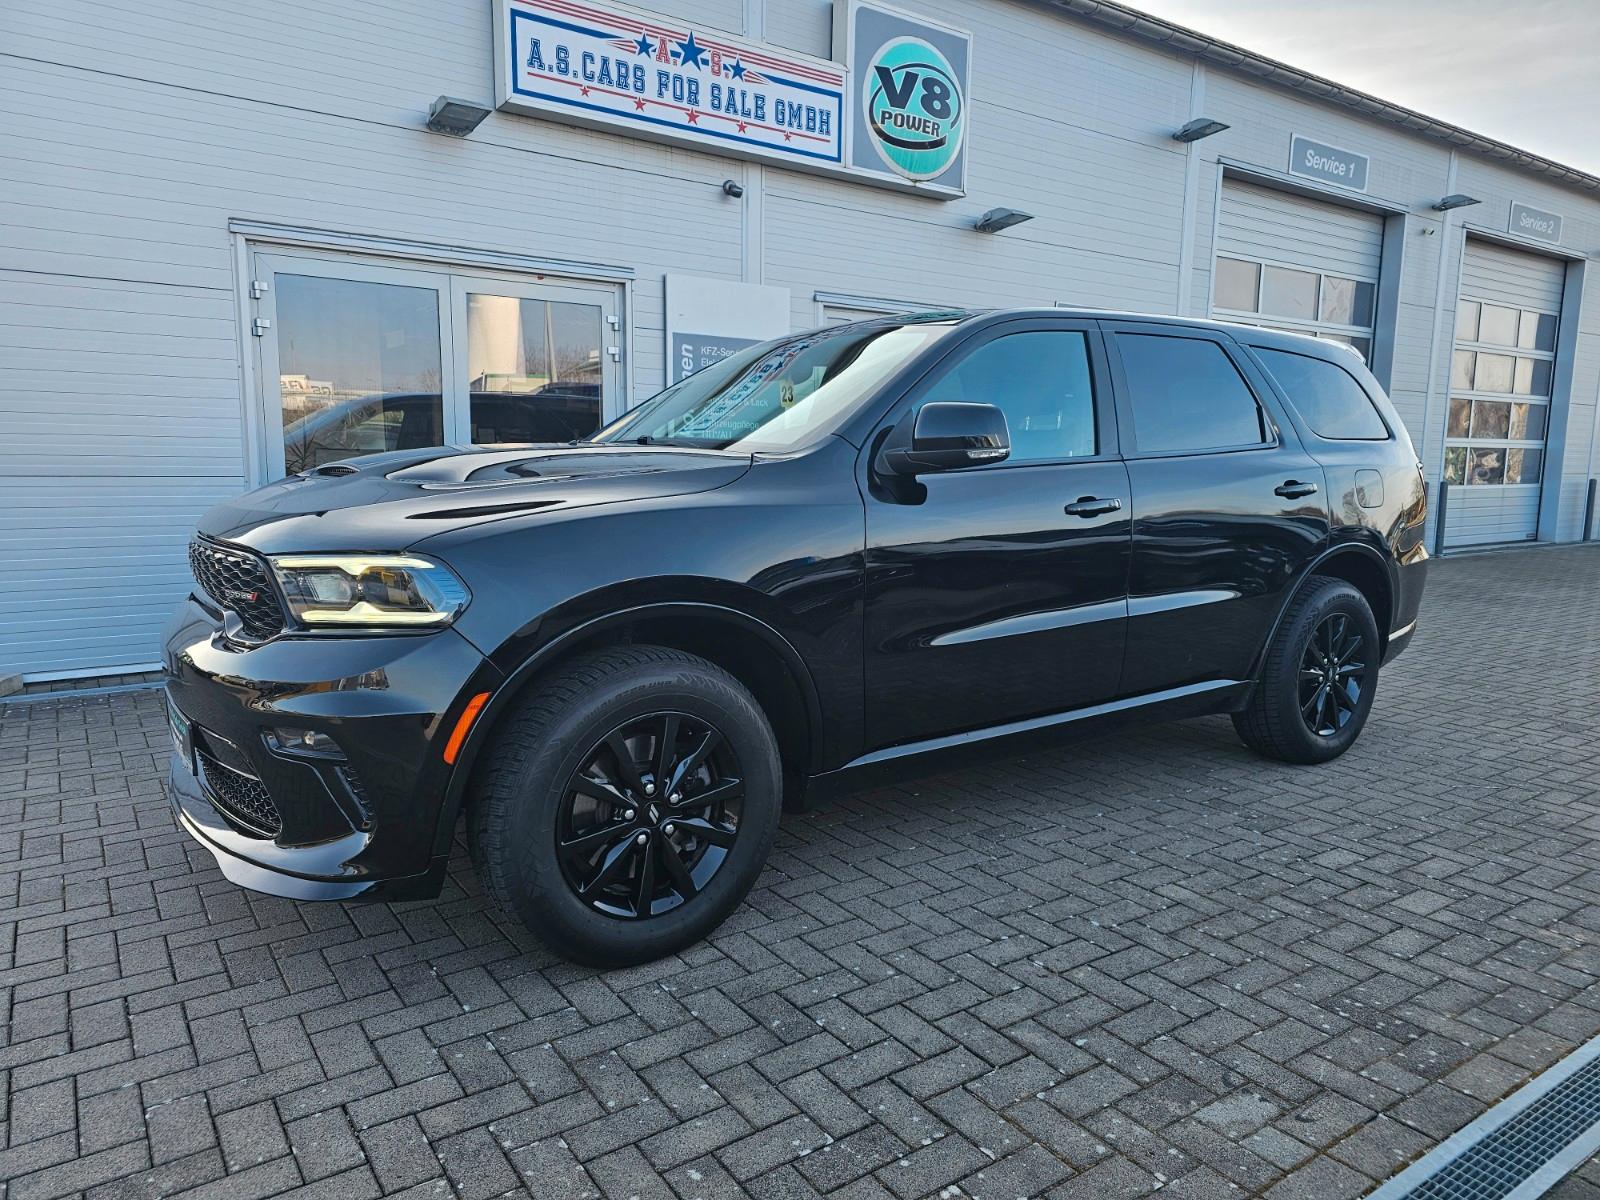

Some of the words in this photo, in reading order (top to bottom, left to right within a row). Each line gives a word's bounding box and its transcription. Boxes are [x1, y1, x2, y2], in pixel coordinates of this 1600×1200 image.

[657, 70, 700, 107] FOR
[711, 84, 766, 120] SALE
[775, 99, 832, 136] GMBH
[874, 65, 952, 120] V8
[880, 110, 941, 138] POWER
[1305, 150, 1346, 176] Service
[1348, 162, 1356, 178] 1
[1520, 212, 1547, 232] Service
[1548, 221, 1555, 234] 2
[781, 386, 793, 403] 23
